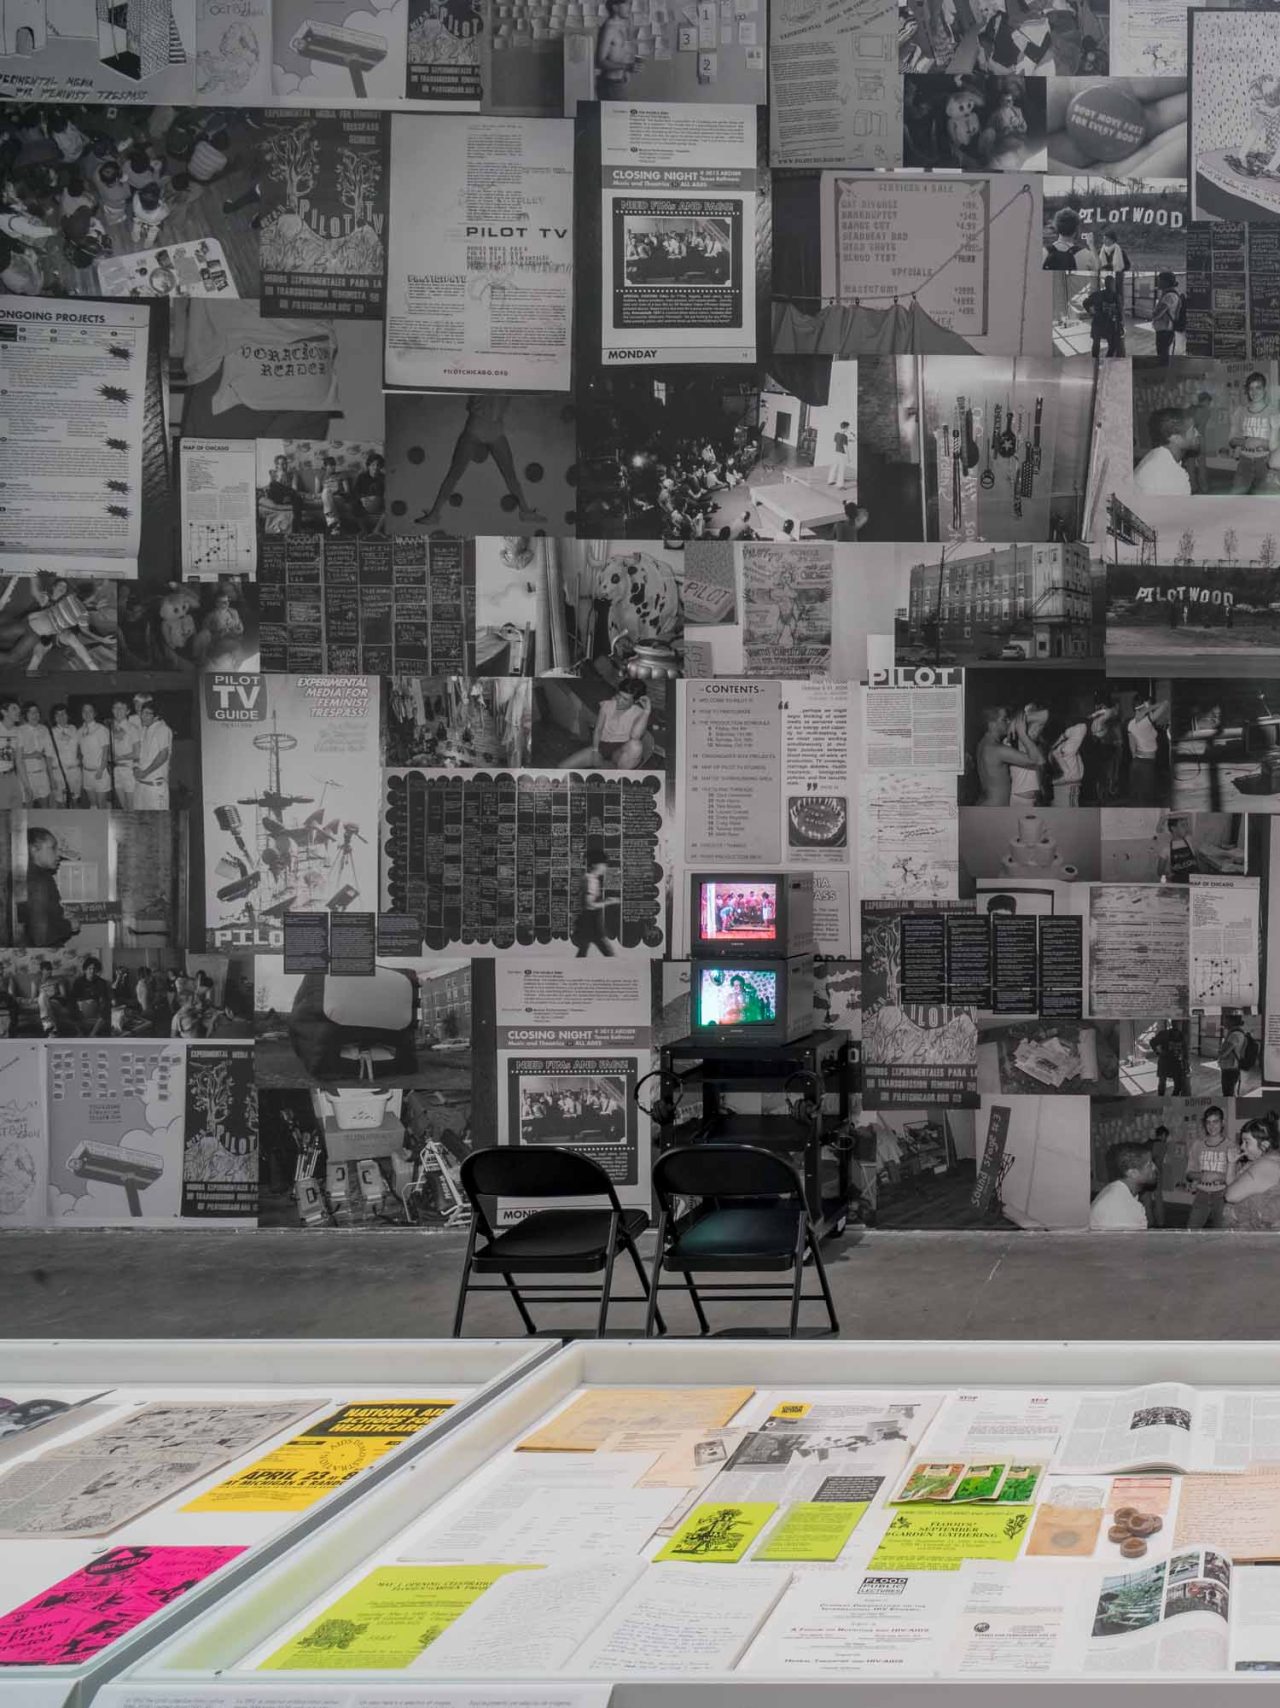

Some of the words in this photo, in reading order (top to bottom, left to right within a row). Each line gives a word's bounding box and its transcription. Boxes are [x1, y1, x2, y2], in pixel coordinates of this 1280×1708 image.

[612, 170, 661, 181] CLOSING
[664, 170, 699, 182] NIGHT
[466, 227, 528, 239] PILOT
[539, 228, 569, 240] TV
[56, 312, 106, 325] PROJECTS
[607, 348, 658, 359] MONDAY
[686, 581, 731, 606] PILOT
[214, 675, 260, 685] PILOT
[297, 677, 369, 688] EXPERIMENTAL
[868, 667, 955, 687] PILOT
[304, 688, 342, 698] MEDIA
[345, 688, 369, 697] FOR
[705, 684, 760, 694] CONTENTS
[212, 685, 261, 709] TV
[318, 698, 368, 708] FEMINIST
[215, 710, 260, 720] GUIDE
[310, 708, 368, 718] TRESPASS!
[507, 1030, 556, 1041] CLOSING
[558, 1030, 594, 1041] NIGHT
[346, 1407, 421, 1418] NATIONAL
[240, 1471, 297, 1481] APRIL
[302, 1471, 330, 1481] 23
[342, 1471, 358, 1481] 8
